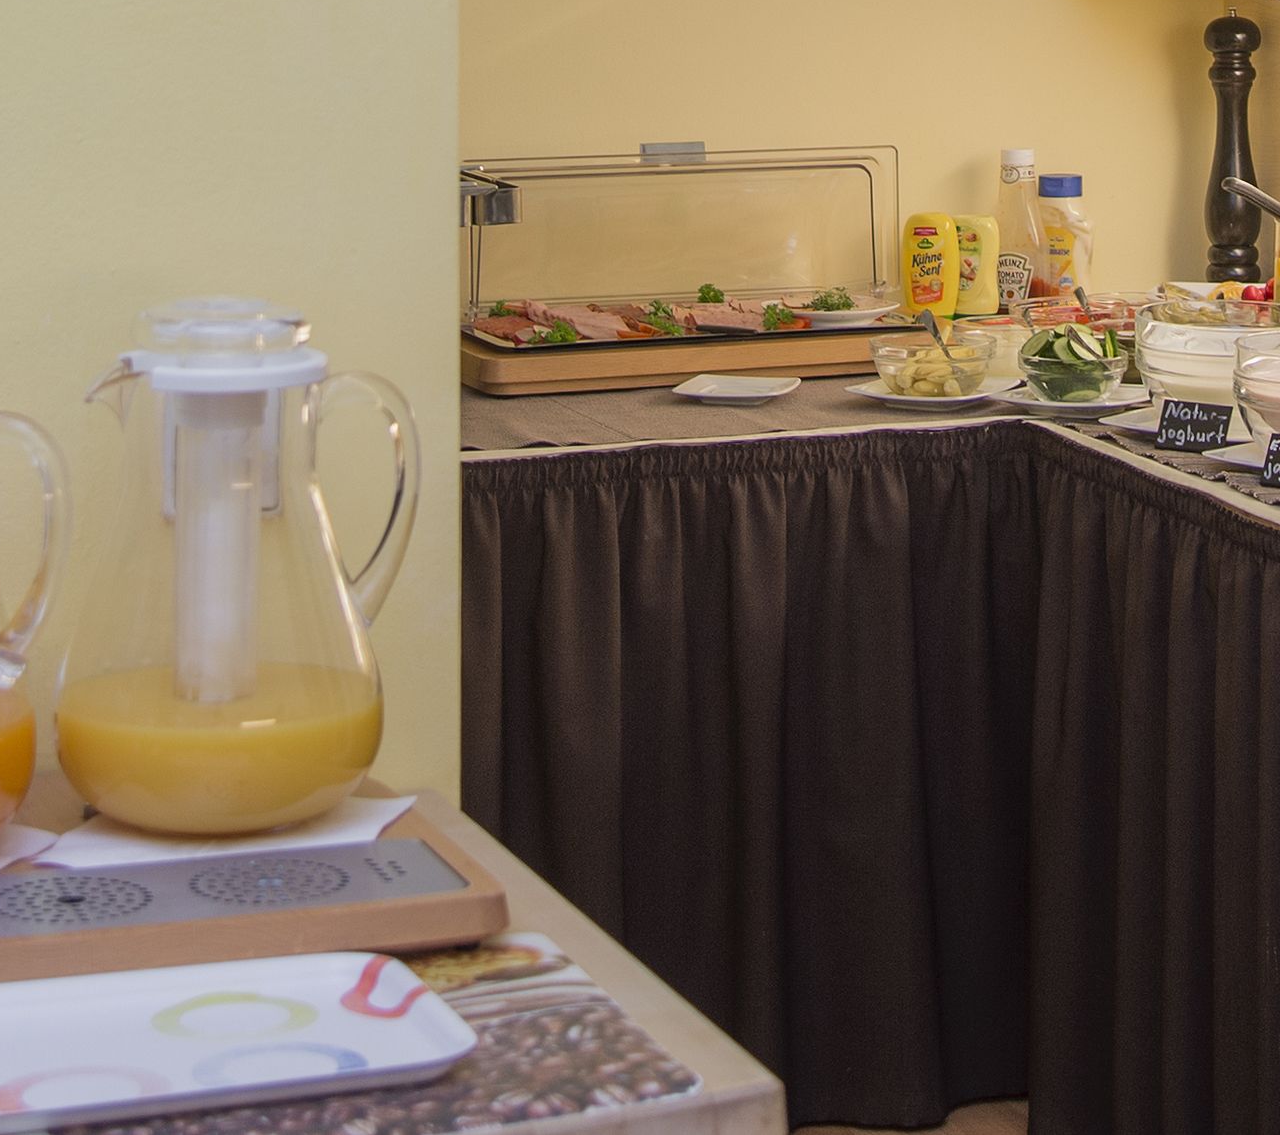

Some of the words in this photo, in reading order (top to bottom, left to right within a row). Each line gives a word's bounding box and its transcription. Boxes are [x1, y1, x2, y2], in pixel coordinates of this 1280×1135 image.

[912, 253, 942, 268] Kühne
[998, 258, 1023, 268] HEINZ
[919, 262, 943, 278] Senf
[998, 270, 1025, 280] TOMATO
[1157, 420, 1226, 447] joghurt
